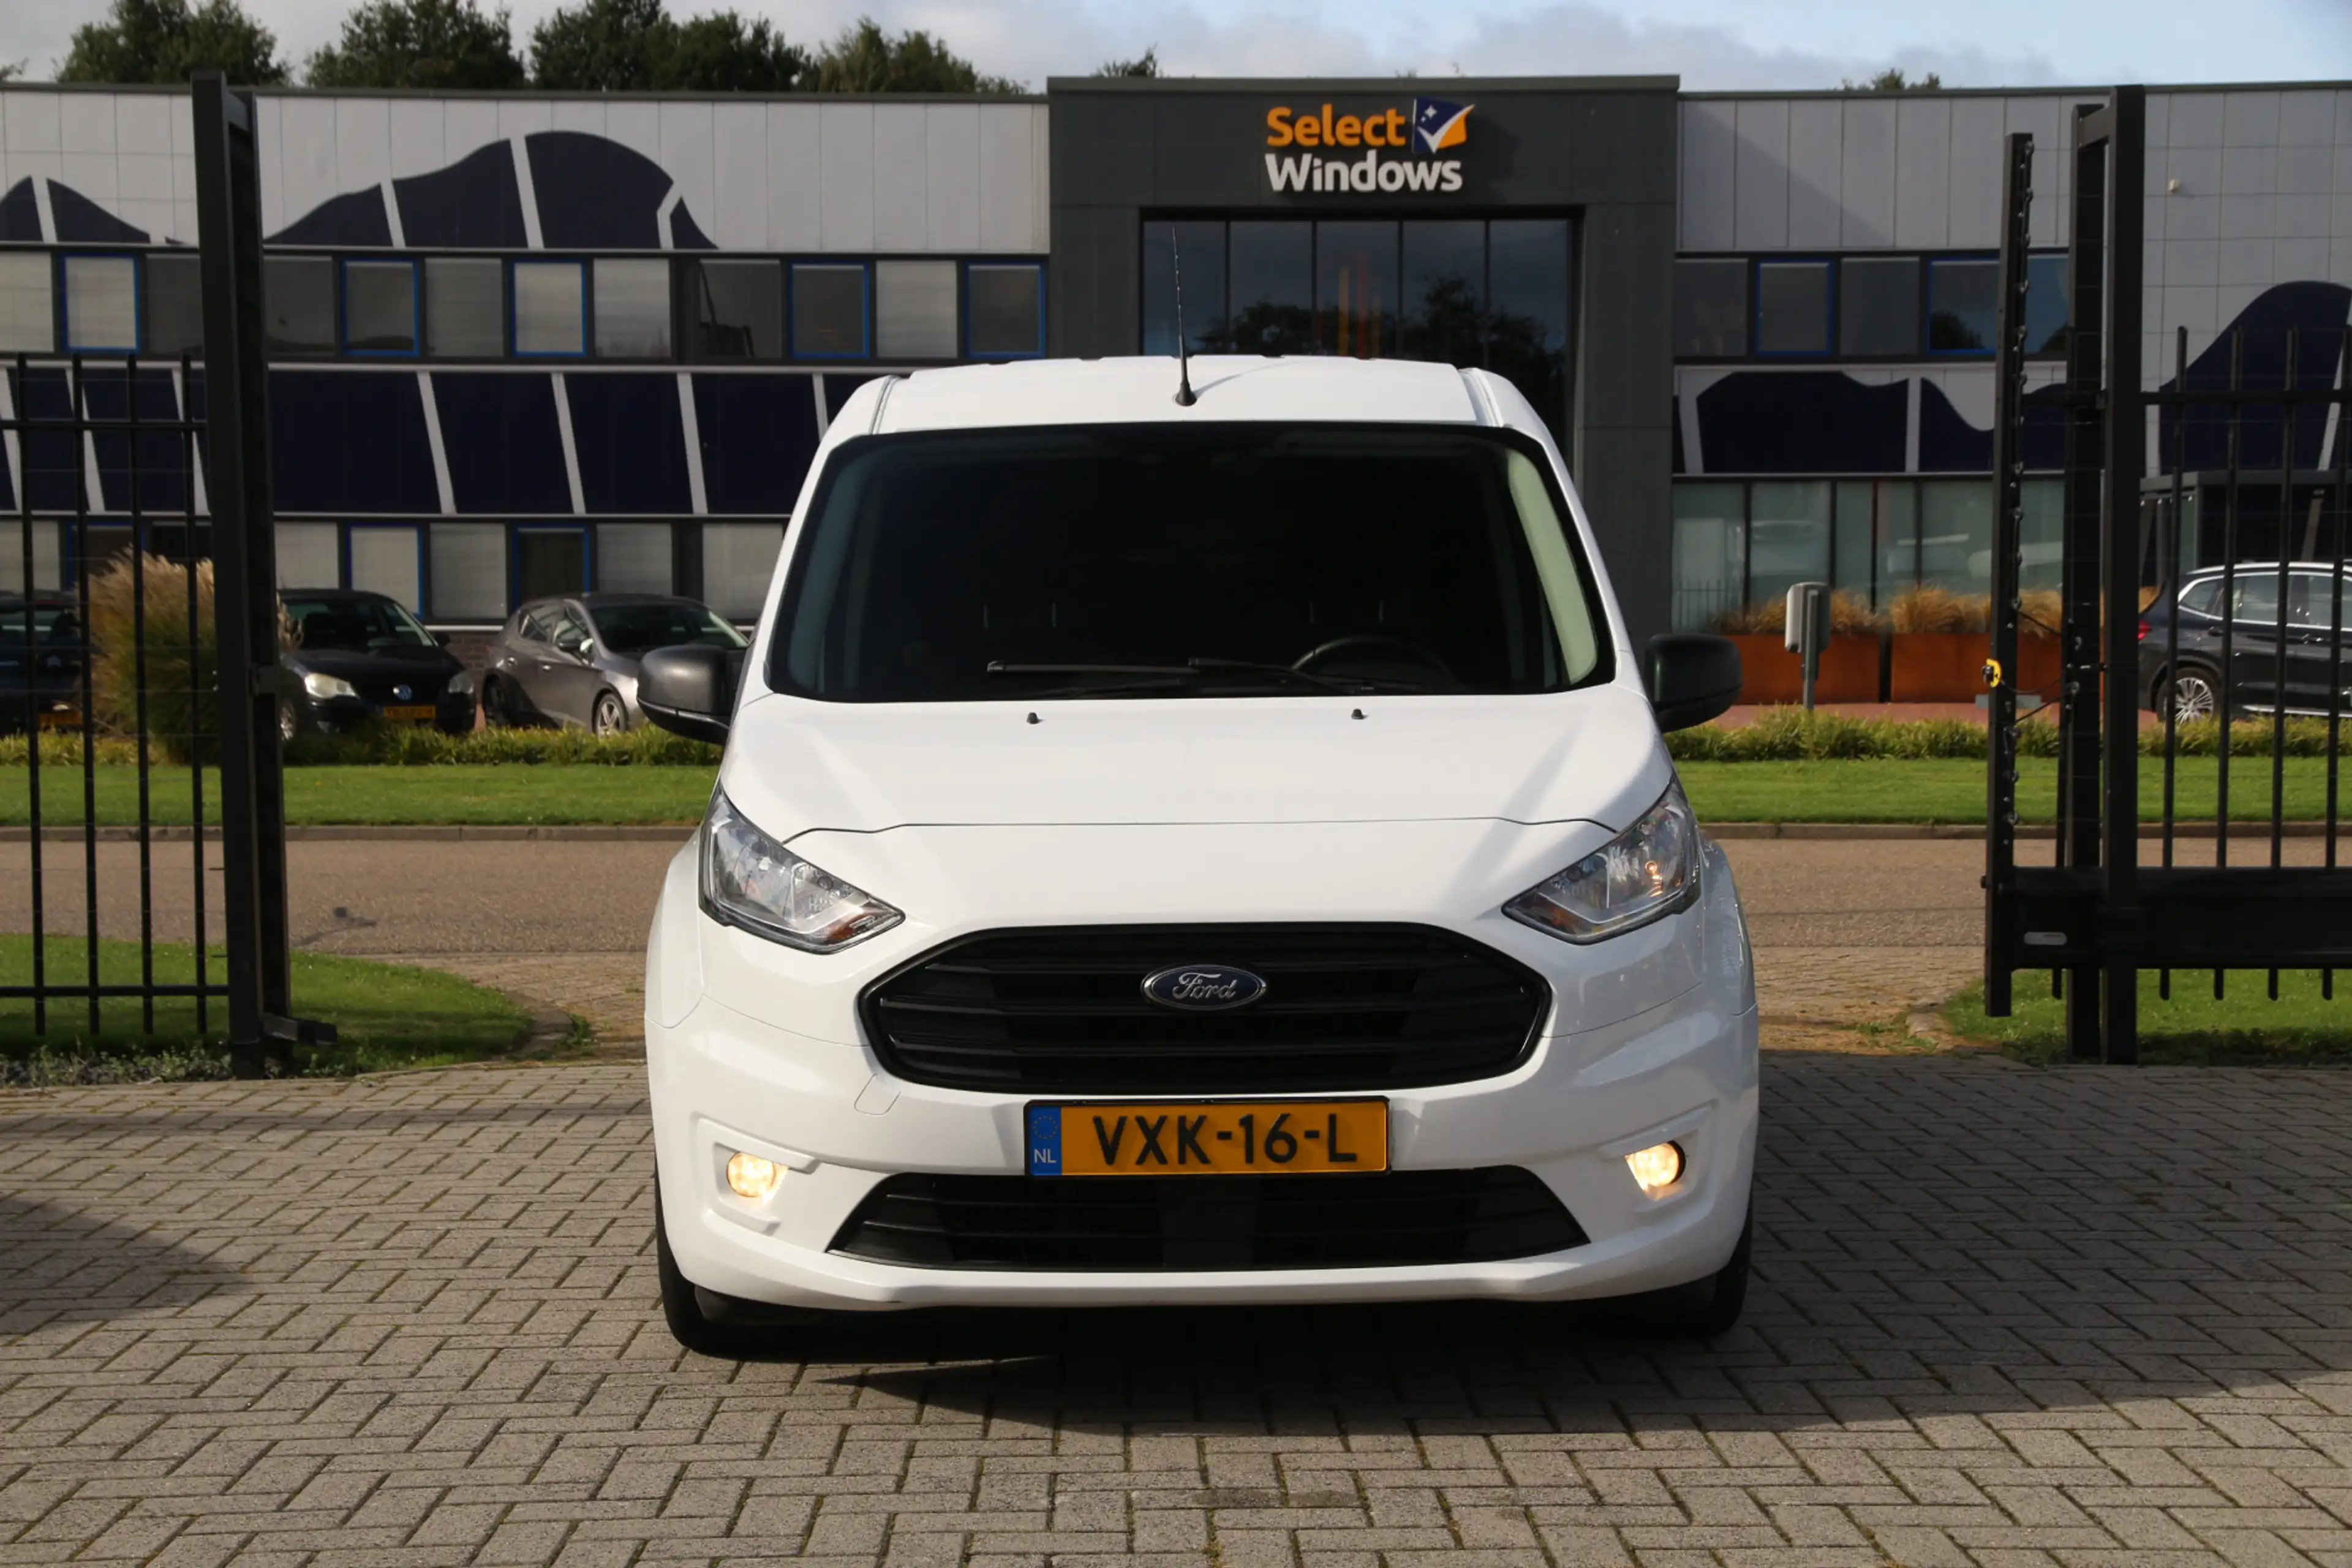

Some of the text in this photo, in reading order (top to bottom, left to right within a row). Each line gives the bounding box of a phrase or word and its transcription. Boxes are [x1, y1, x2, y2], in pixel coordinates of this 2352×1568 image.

[1267, 103, 1406, 146] Select
[1265, 149, 1463, 192] Windows
[1172, 971, 1237, 1000] Ford
[1033, 1148, 1057, 1164] NL
[1093, 1113, 1358, 1166] VXK-16-L
